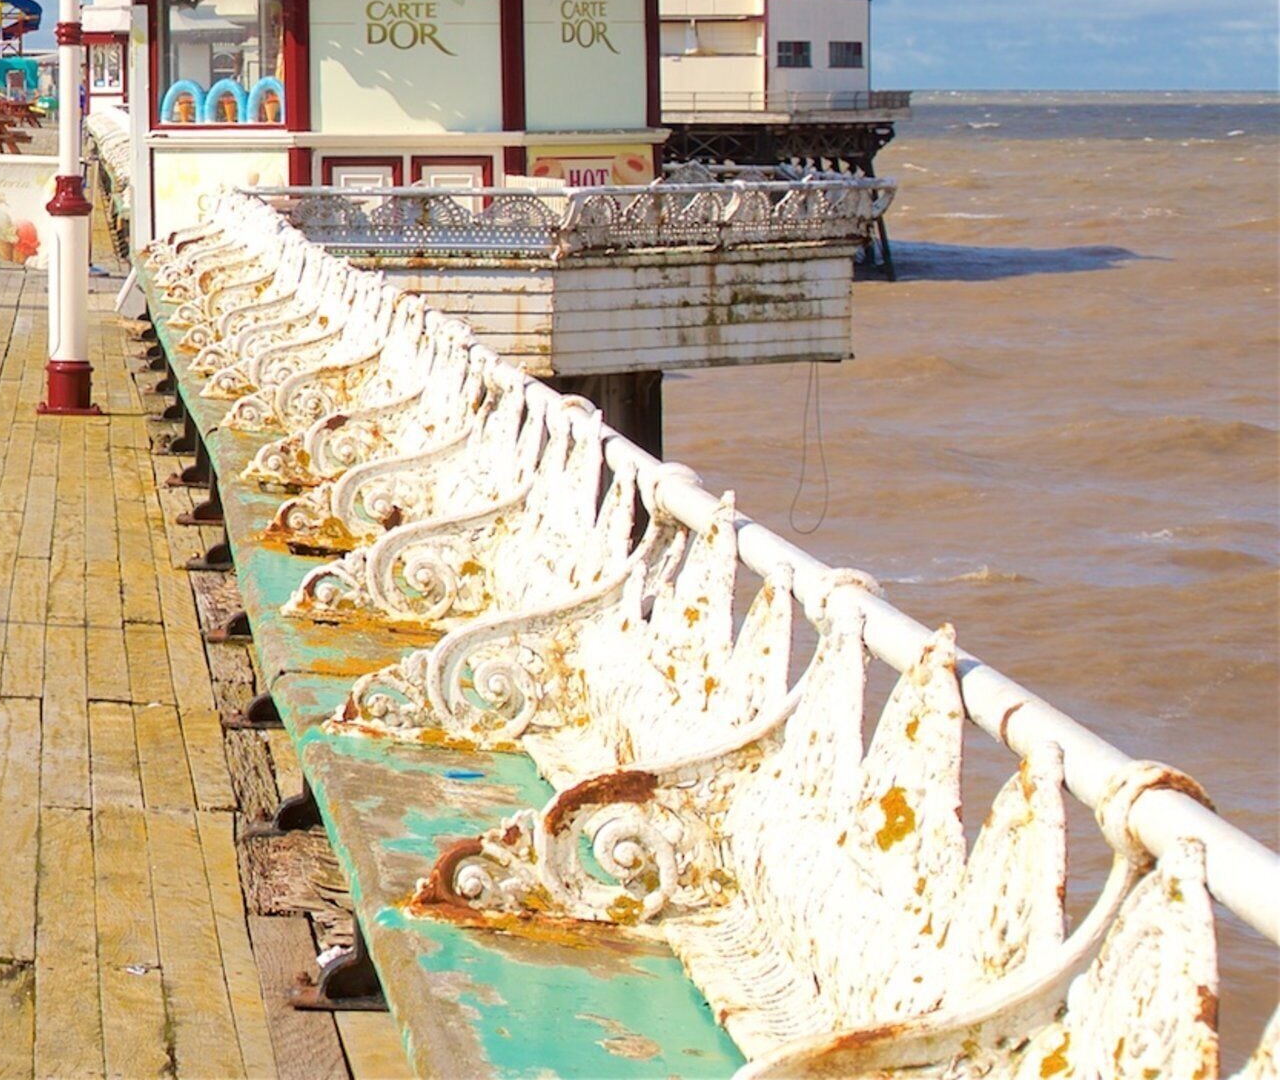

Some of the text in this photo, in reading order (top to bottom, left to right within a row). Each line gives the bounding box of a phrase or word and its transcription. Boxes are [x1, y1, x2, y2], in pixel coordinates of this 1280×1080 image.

[366, 0, 438, 21] CARTE
[561, 0, 608, 20] CARTE
[366, 19, 459, 57] D'OR
[561, 18, 621, 55] D'OR
[569, 168, 609, 187] HOT
